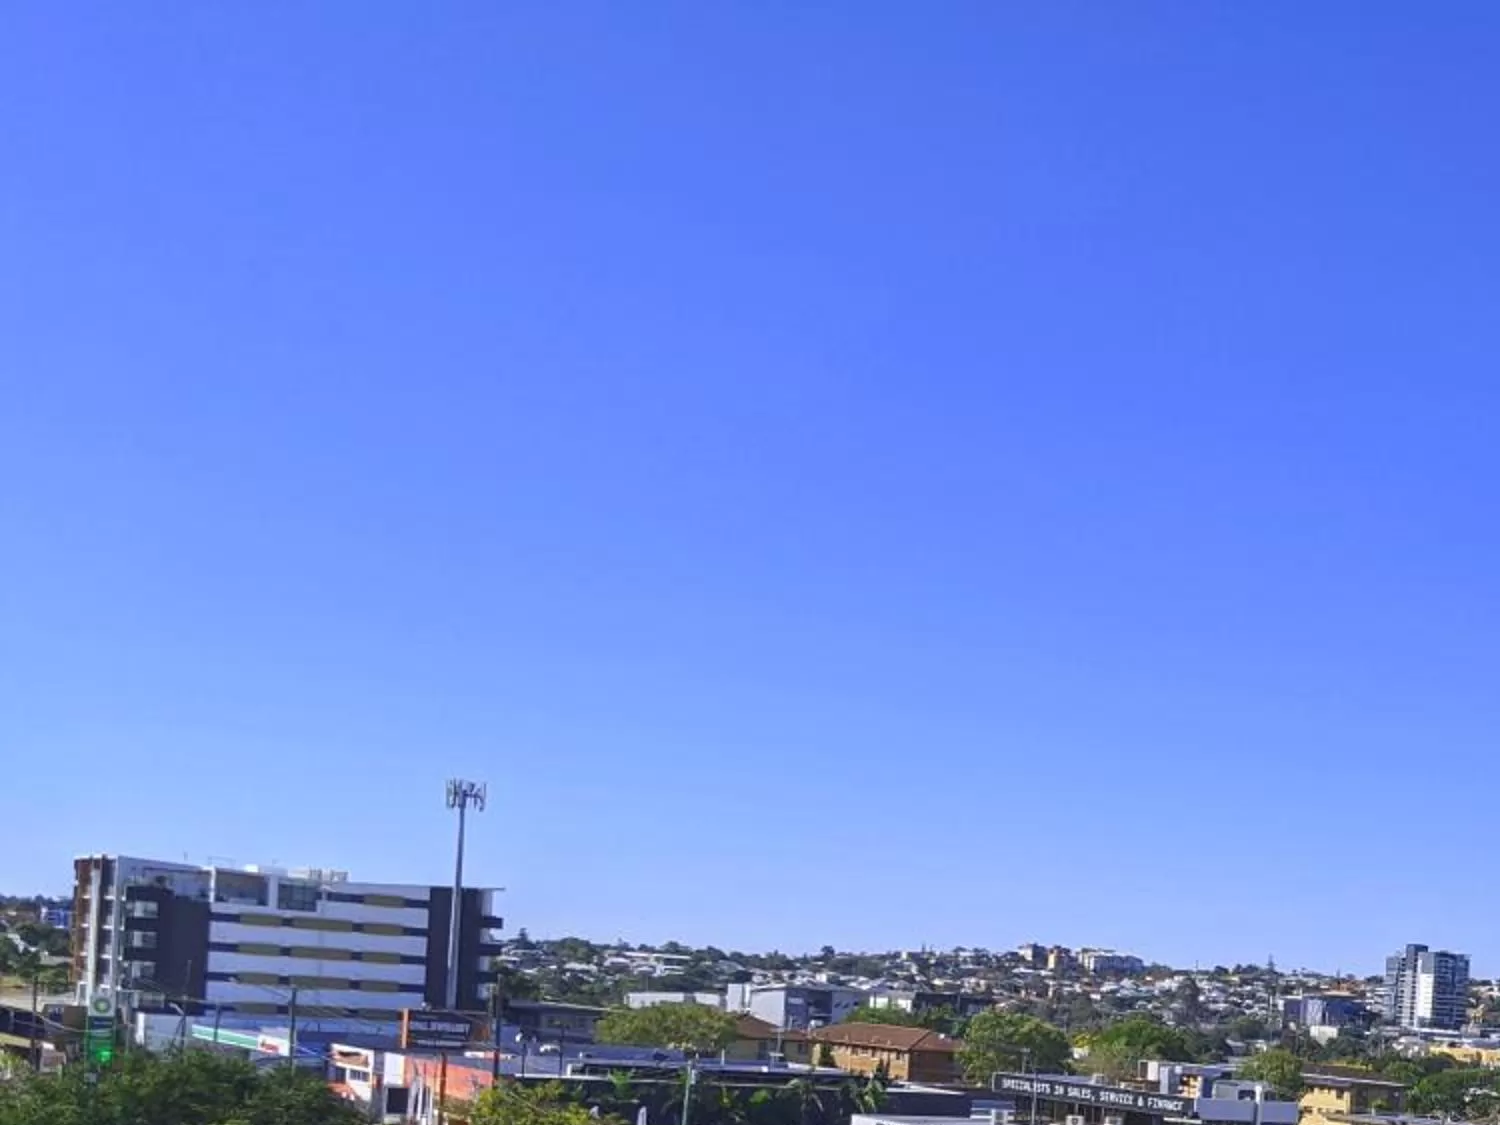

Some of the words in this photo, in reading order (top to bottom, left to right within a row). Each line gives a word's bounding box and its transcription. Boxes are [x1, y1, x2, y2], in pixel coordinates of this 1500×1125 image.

[1002, 1077, 1051, 1094] SPECIALISTS
[1053, 1084, 1065, 1096] IN
[1067, 1086, 1095, 1101] SALES,
[1099, 1091, 1134, 1106] SERVICE
[1137, 1096, 1145, 1107] &
[1147, 1097, 1184, 1111] FINANCE
